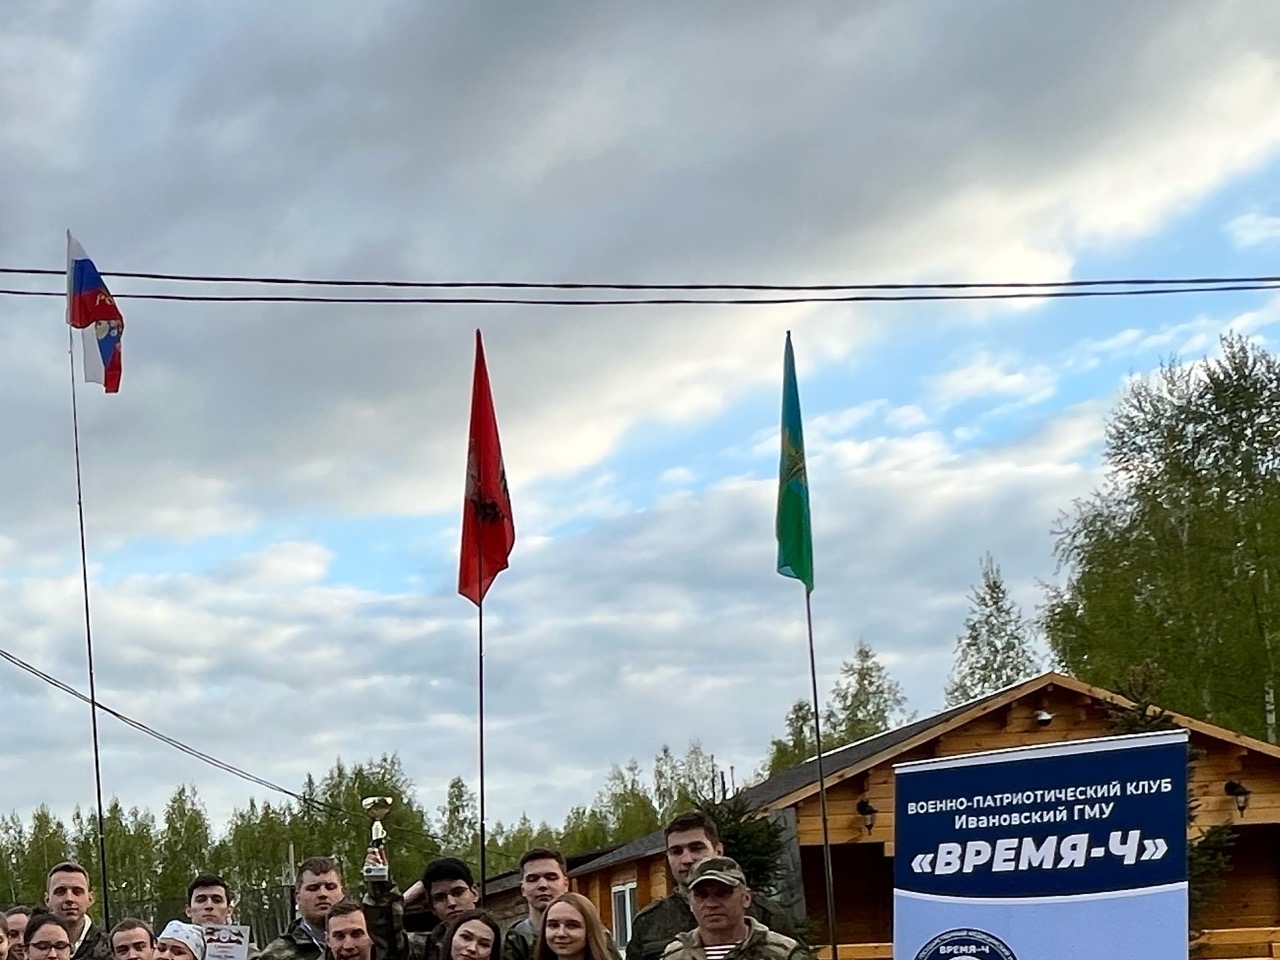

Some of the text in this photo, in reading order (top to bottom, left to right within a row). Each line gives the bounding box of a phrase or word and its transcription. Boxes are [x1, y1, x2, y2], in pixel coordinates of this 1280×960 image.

[907, 778, 1173, 815] ВОЕННО-ПАТРИОТИЧЕСКИЙ КЛУБ
[954, 802, 1115, 830] Ивановский ГМУ
[910, 830, 1169, 875] «ВРЕМЯ-Ч»
[939, 944, 990, 955] ВРЕМЯ-Ч
